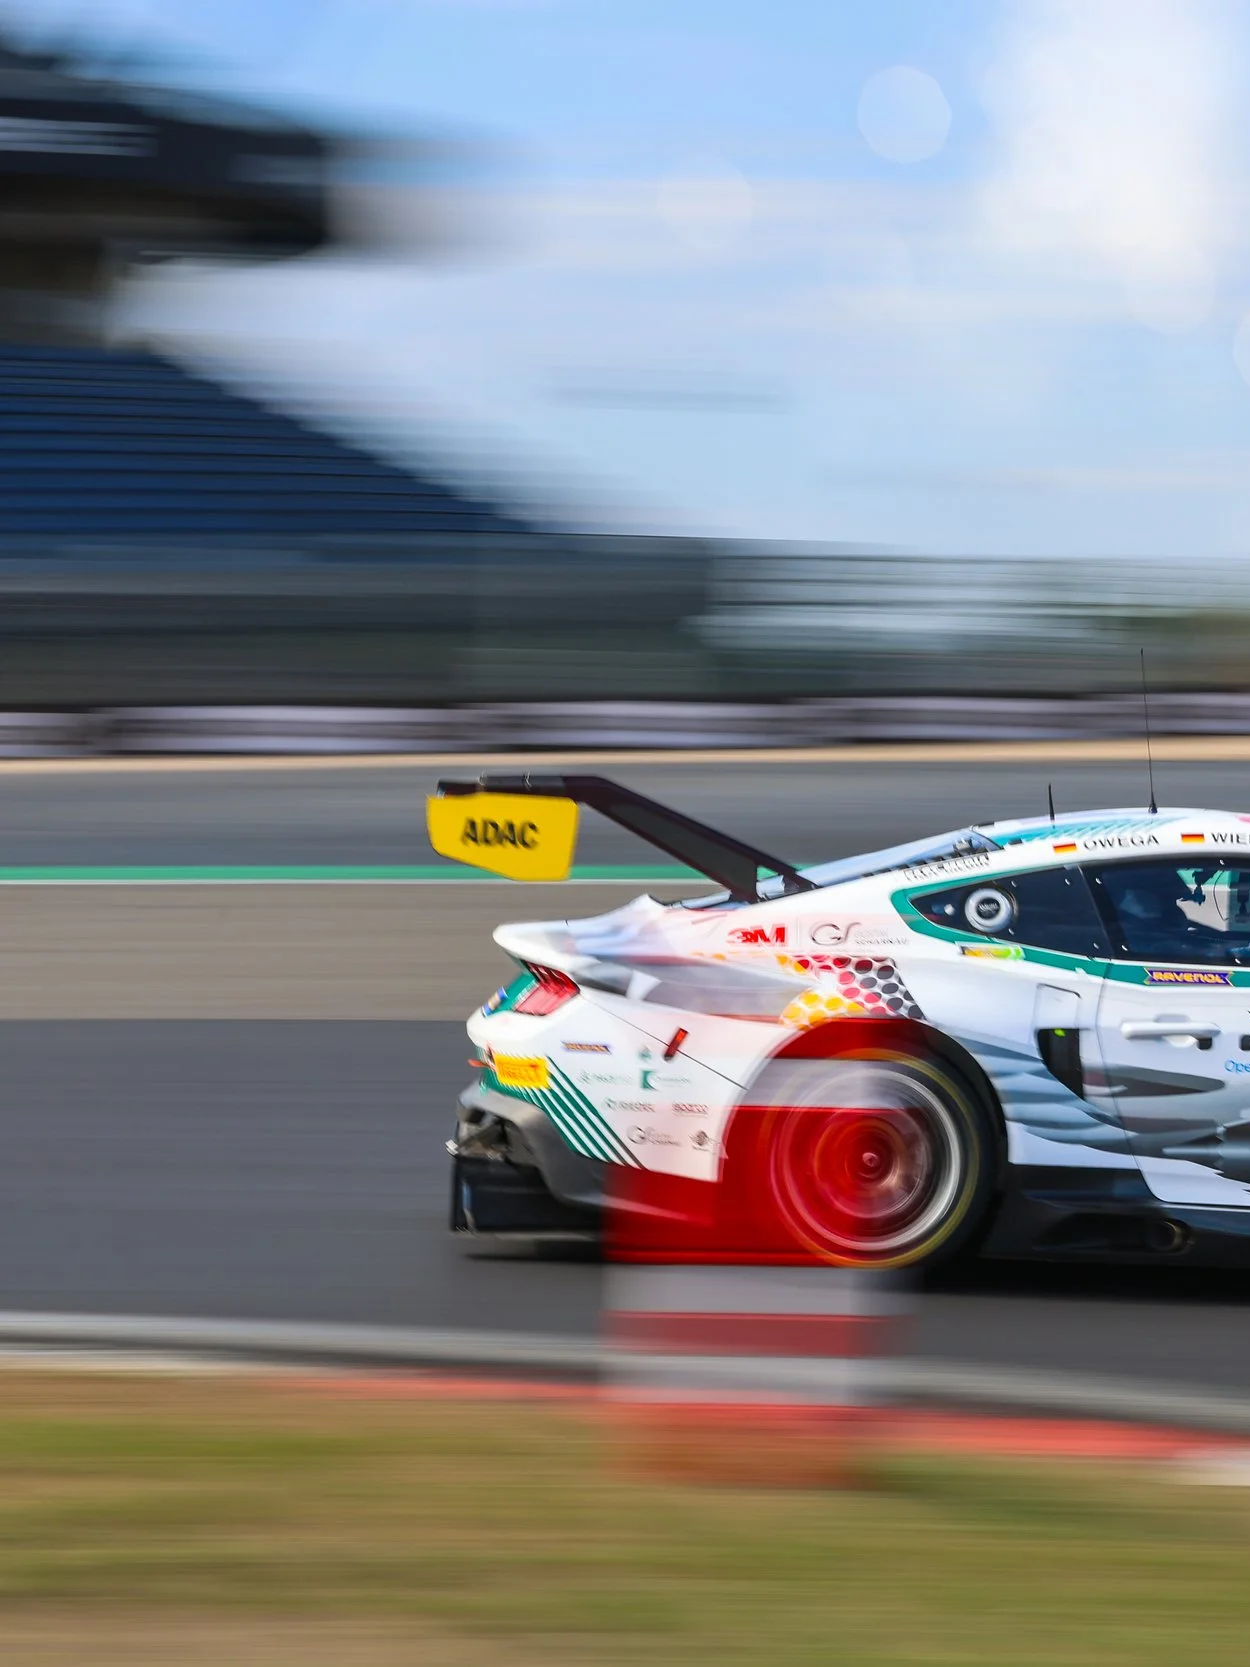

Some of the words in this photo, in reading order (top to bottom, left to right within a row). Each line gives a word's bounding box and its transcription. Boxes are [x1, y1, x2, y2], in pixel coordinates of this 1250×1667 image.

[461, 817, 540, 849] ADAC
[1083, 834, 1160, 851] OWEGA
[1152, 971, 1226, 984] RAVENOL
